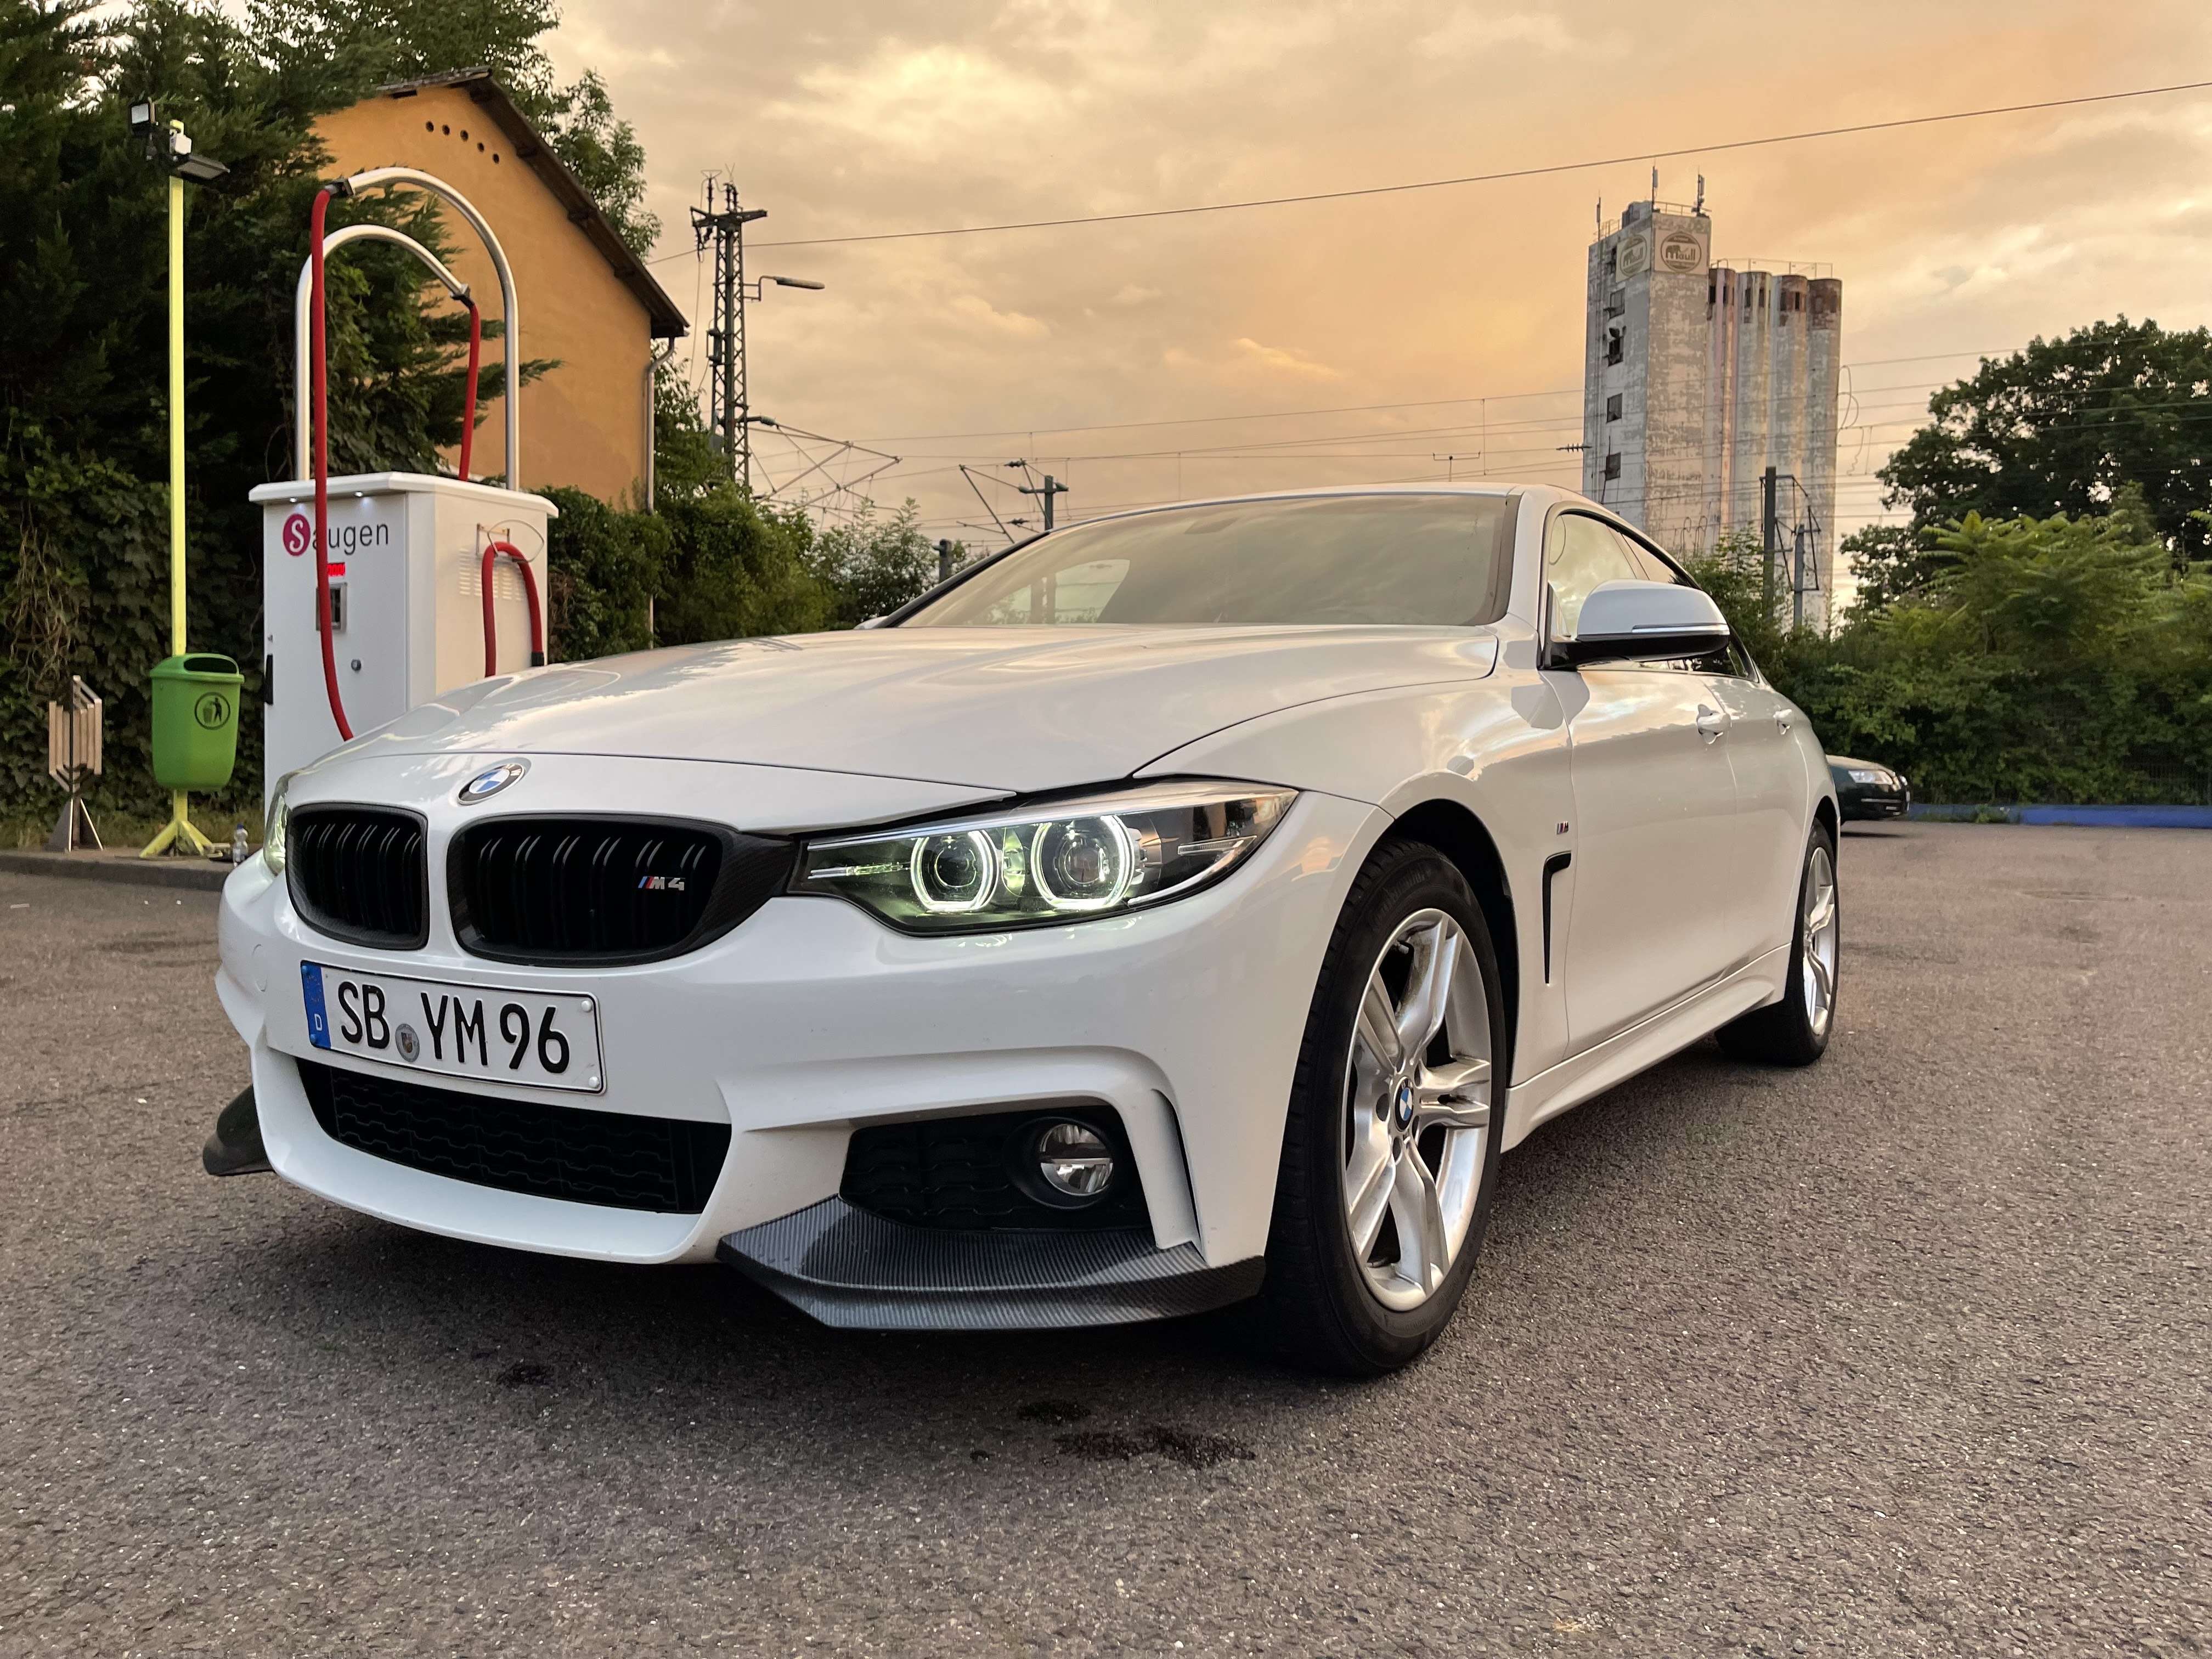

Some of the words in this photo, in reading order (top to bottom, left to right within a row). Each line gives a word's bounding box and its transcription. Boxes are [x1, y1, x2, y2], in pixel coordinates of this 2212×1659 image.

[648, 876, 685, 891] M4
[314, 1013, 323, 1031] D
[338, 981, 390, 1049] SB
[420, 992, 488, 1065] YM
[500, 1003, 569, 1074] 96
